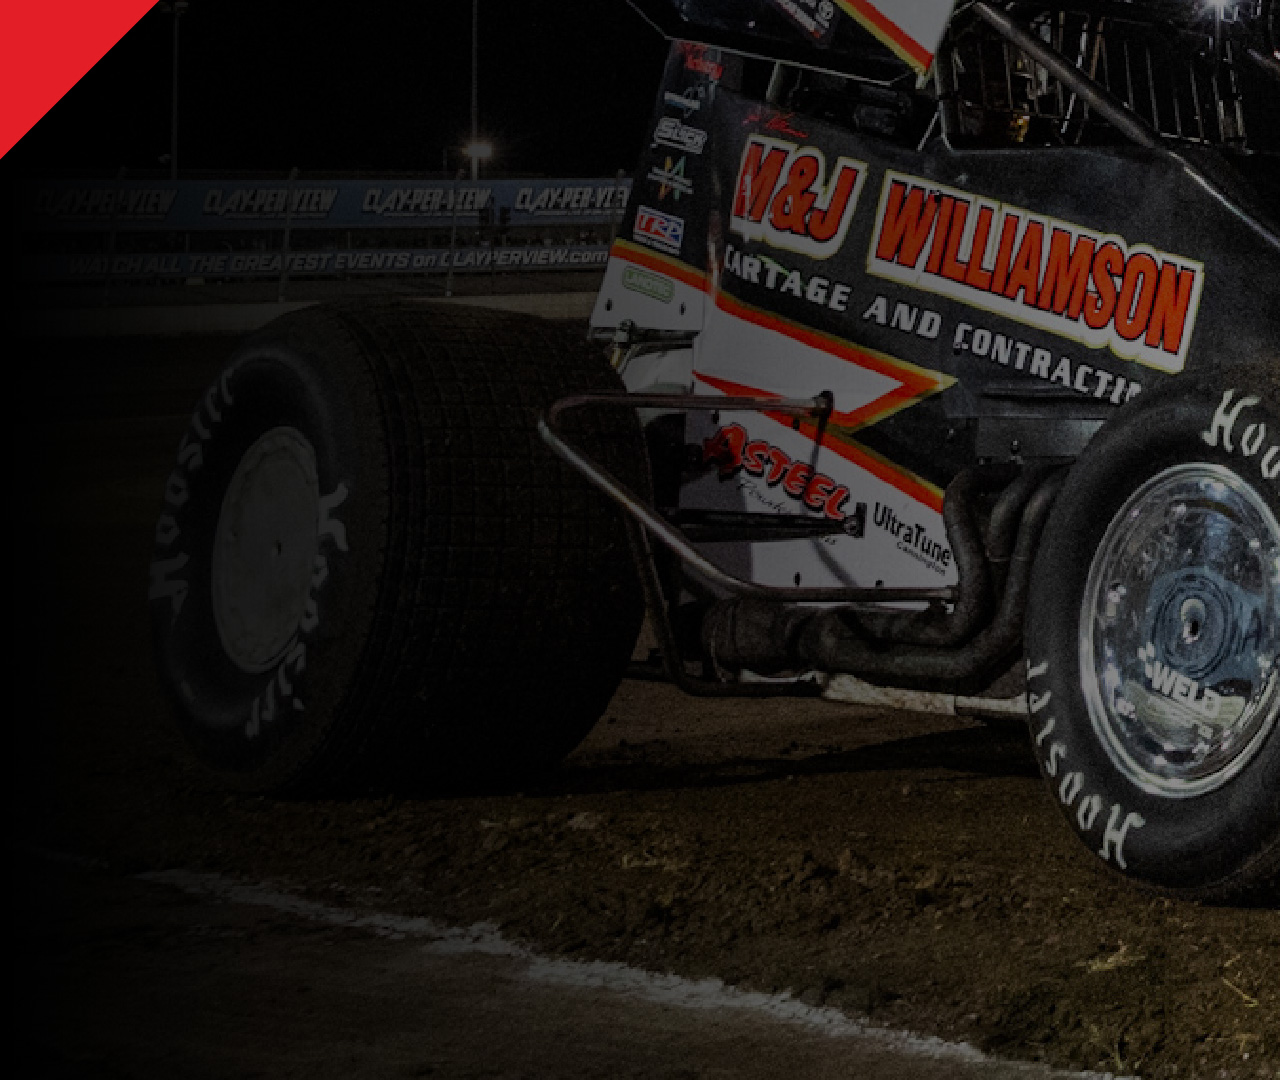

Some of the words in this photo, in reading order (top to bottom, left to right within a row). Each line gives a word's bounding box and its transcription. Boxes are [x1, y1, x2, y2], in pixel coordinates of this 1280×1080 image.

[203, 188, 338, 215] CLAY-PER-VIEW
[362, 187, 493, 214] CLAY-PER-VIEW
[515, 186, 629, 212] CLAY-PER-VIE
[732, 139, 861, 244] M&J
[68, 254, 142, 273] WATCH
[149, 254, 182, 273] ALL
[188, 254, 228, 273] THE
[231, 252, 334, 273] GREATEST
[335, 252, 411, 270] EVENTS
[412, 254, 436, 269] on
[724, 243, 854, 313] CARTAGE
[862, 294, 944, 341] AND
[874, 178, 1197, 356] WILLIAMSON
[702, 422, 851, 522] ASTEEL
[873, 501, 951, 567] UltraTune
[1025, 658, 1146, 871] Hoosier
